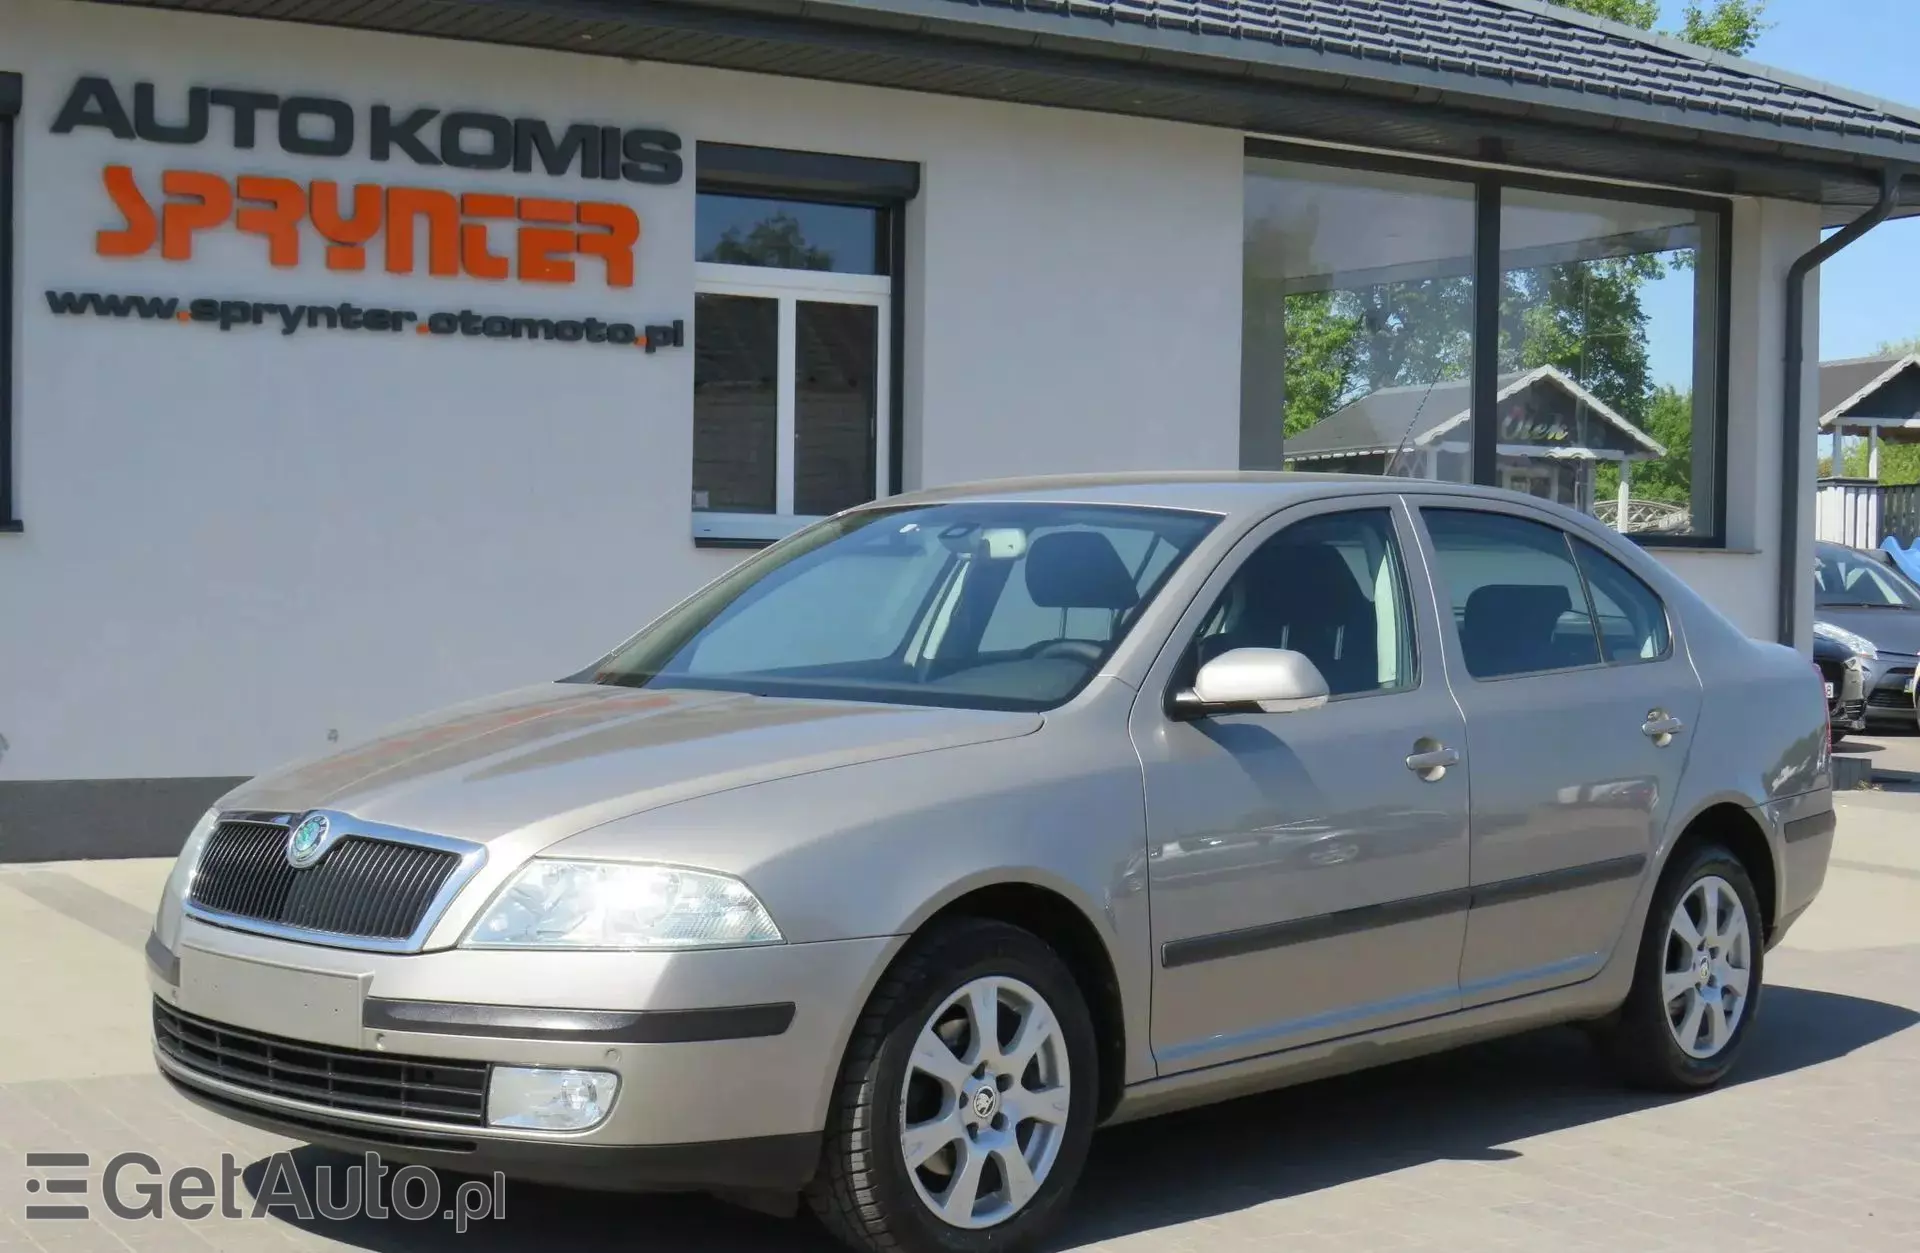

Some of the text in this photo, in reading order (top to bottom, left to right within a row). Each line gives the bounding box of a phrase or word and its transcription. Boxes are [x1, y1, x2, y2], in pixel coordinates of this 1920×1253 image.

[49, 76, 684, 186] AUTO KOMIS
[95, 165, 641, 288] SPRYNTER
[45, 289, 684, 353] www.sprynter.otomoto.pl
